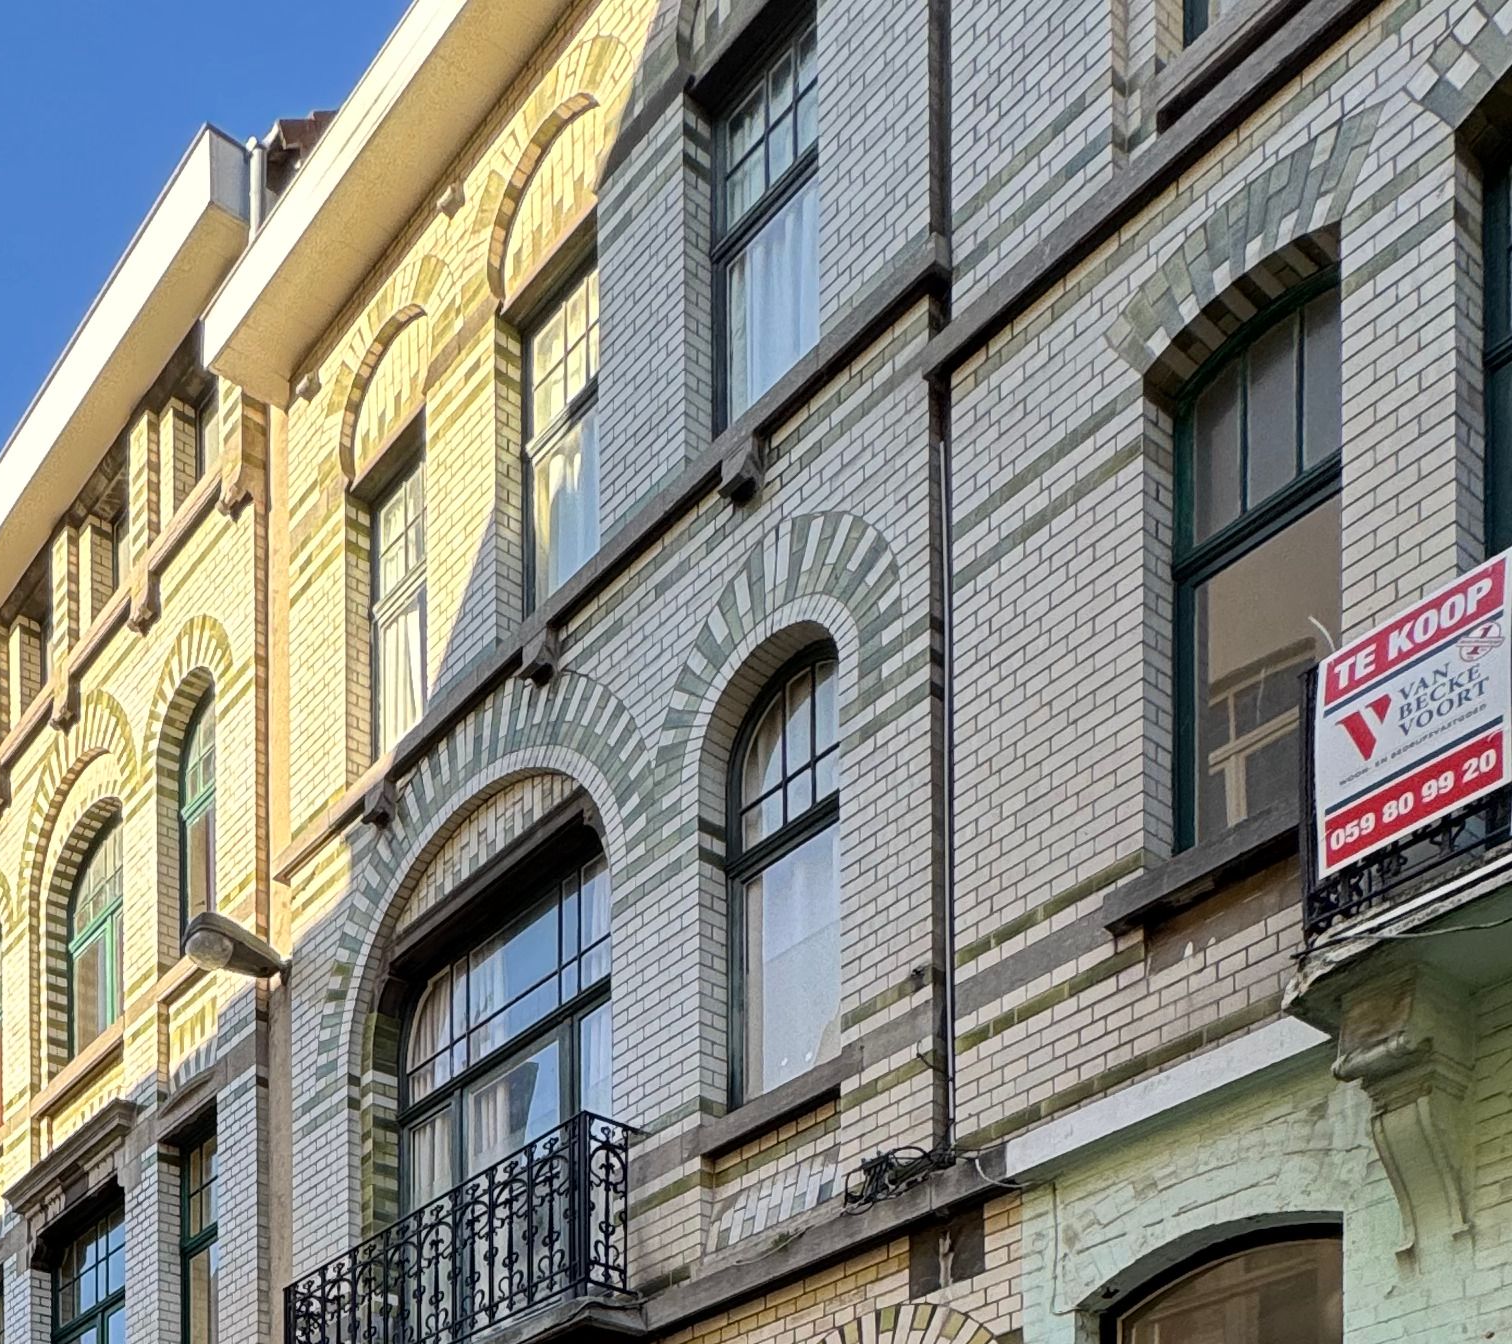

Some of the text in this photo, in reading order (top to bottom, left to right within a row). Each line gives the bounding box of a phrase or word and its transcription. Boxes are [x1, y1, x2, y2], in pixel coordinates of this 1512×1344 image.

[1333, 578, 1493, 690] TE KOOP
[1399, 663, 1450, 700] VAN
[1399, 664, 1481, 721] BECKE
[1399, 677, 1489, 736] VOORT
[1330, 749, 1497, 850] 059 80 99 20
